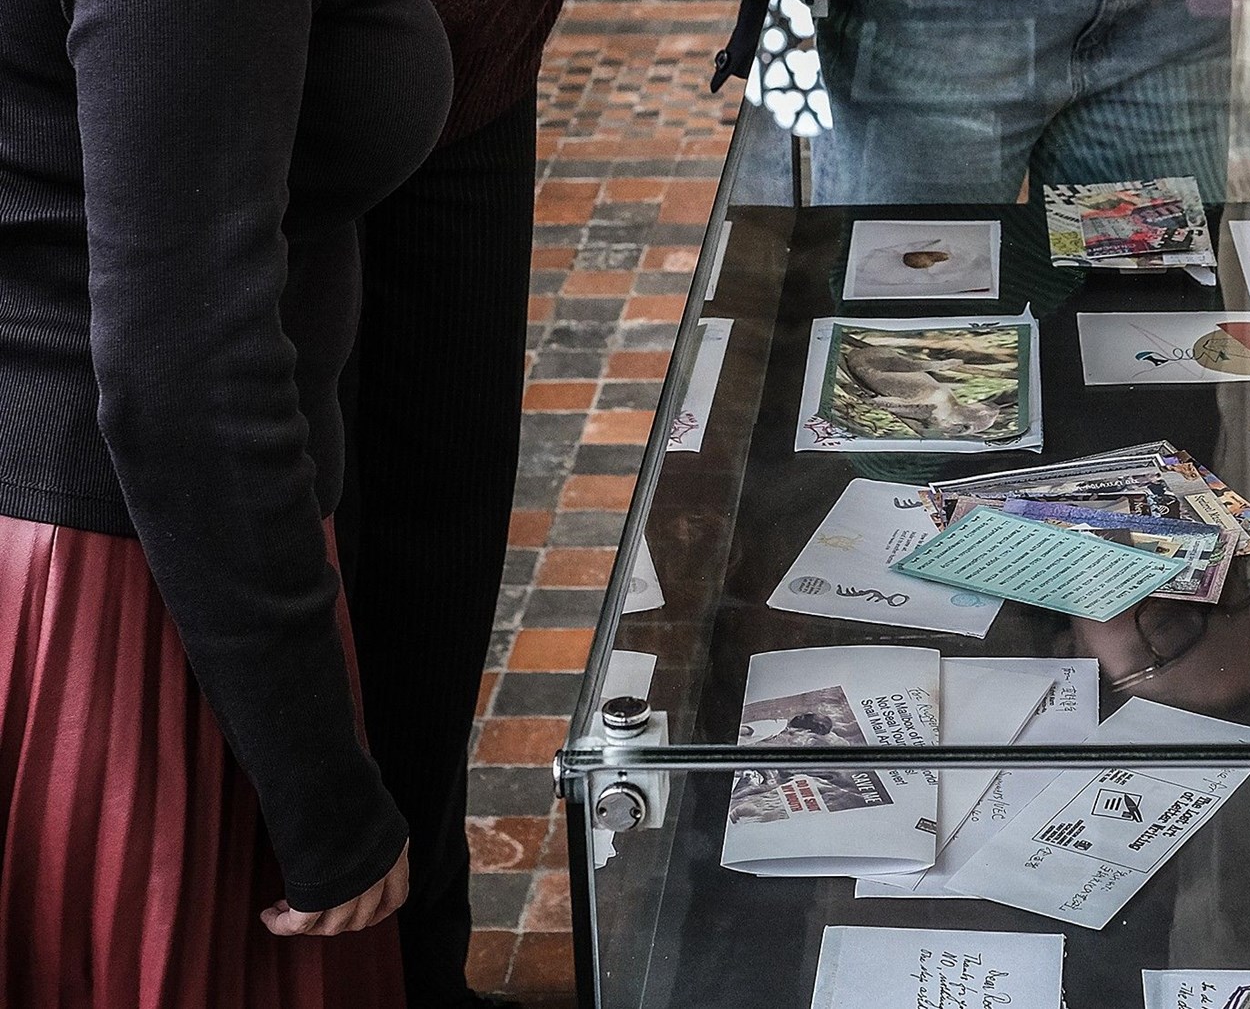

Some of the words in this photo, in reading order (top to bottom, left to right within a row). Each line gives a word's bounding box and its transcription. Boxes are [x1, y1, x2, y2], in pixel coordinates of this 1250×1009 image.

[875, 695, 890, 710] Not
[859, 697, 879, 718] Snail
[869, 717, 886, 734] Mail
[881, 708, 901, 728] Seal
[893, 700, 917, 731] Mailbox
[850, 770, 875, 791] SAVE
[861, 788, 882, 803] ME
[1190, 795, 1212, 810] The
[1155, 799, 1189, 825] Letter
[1174, 808, 1200, 826] Lost
[1126, 821, 1166, 852] Writing
[1161, 824, 1183, 838] Art
[982, 969, 1009, 991] Dear
